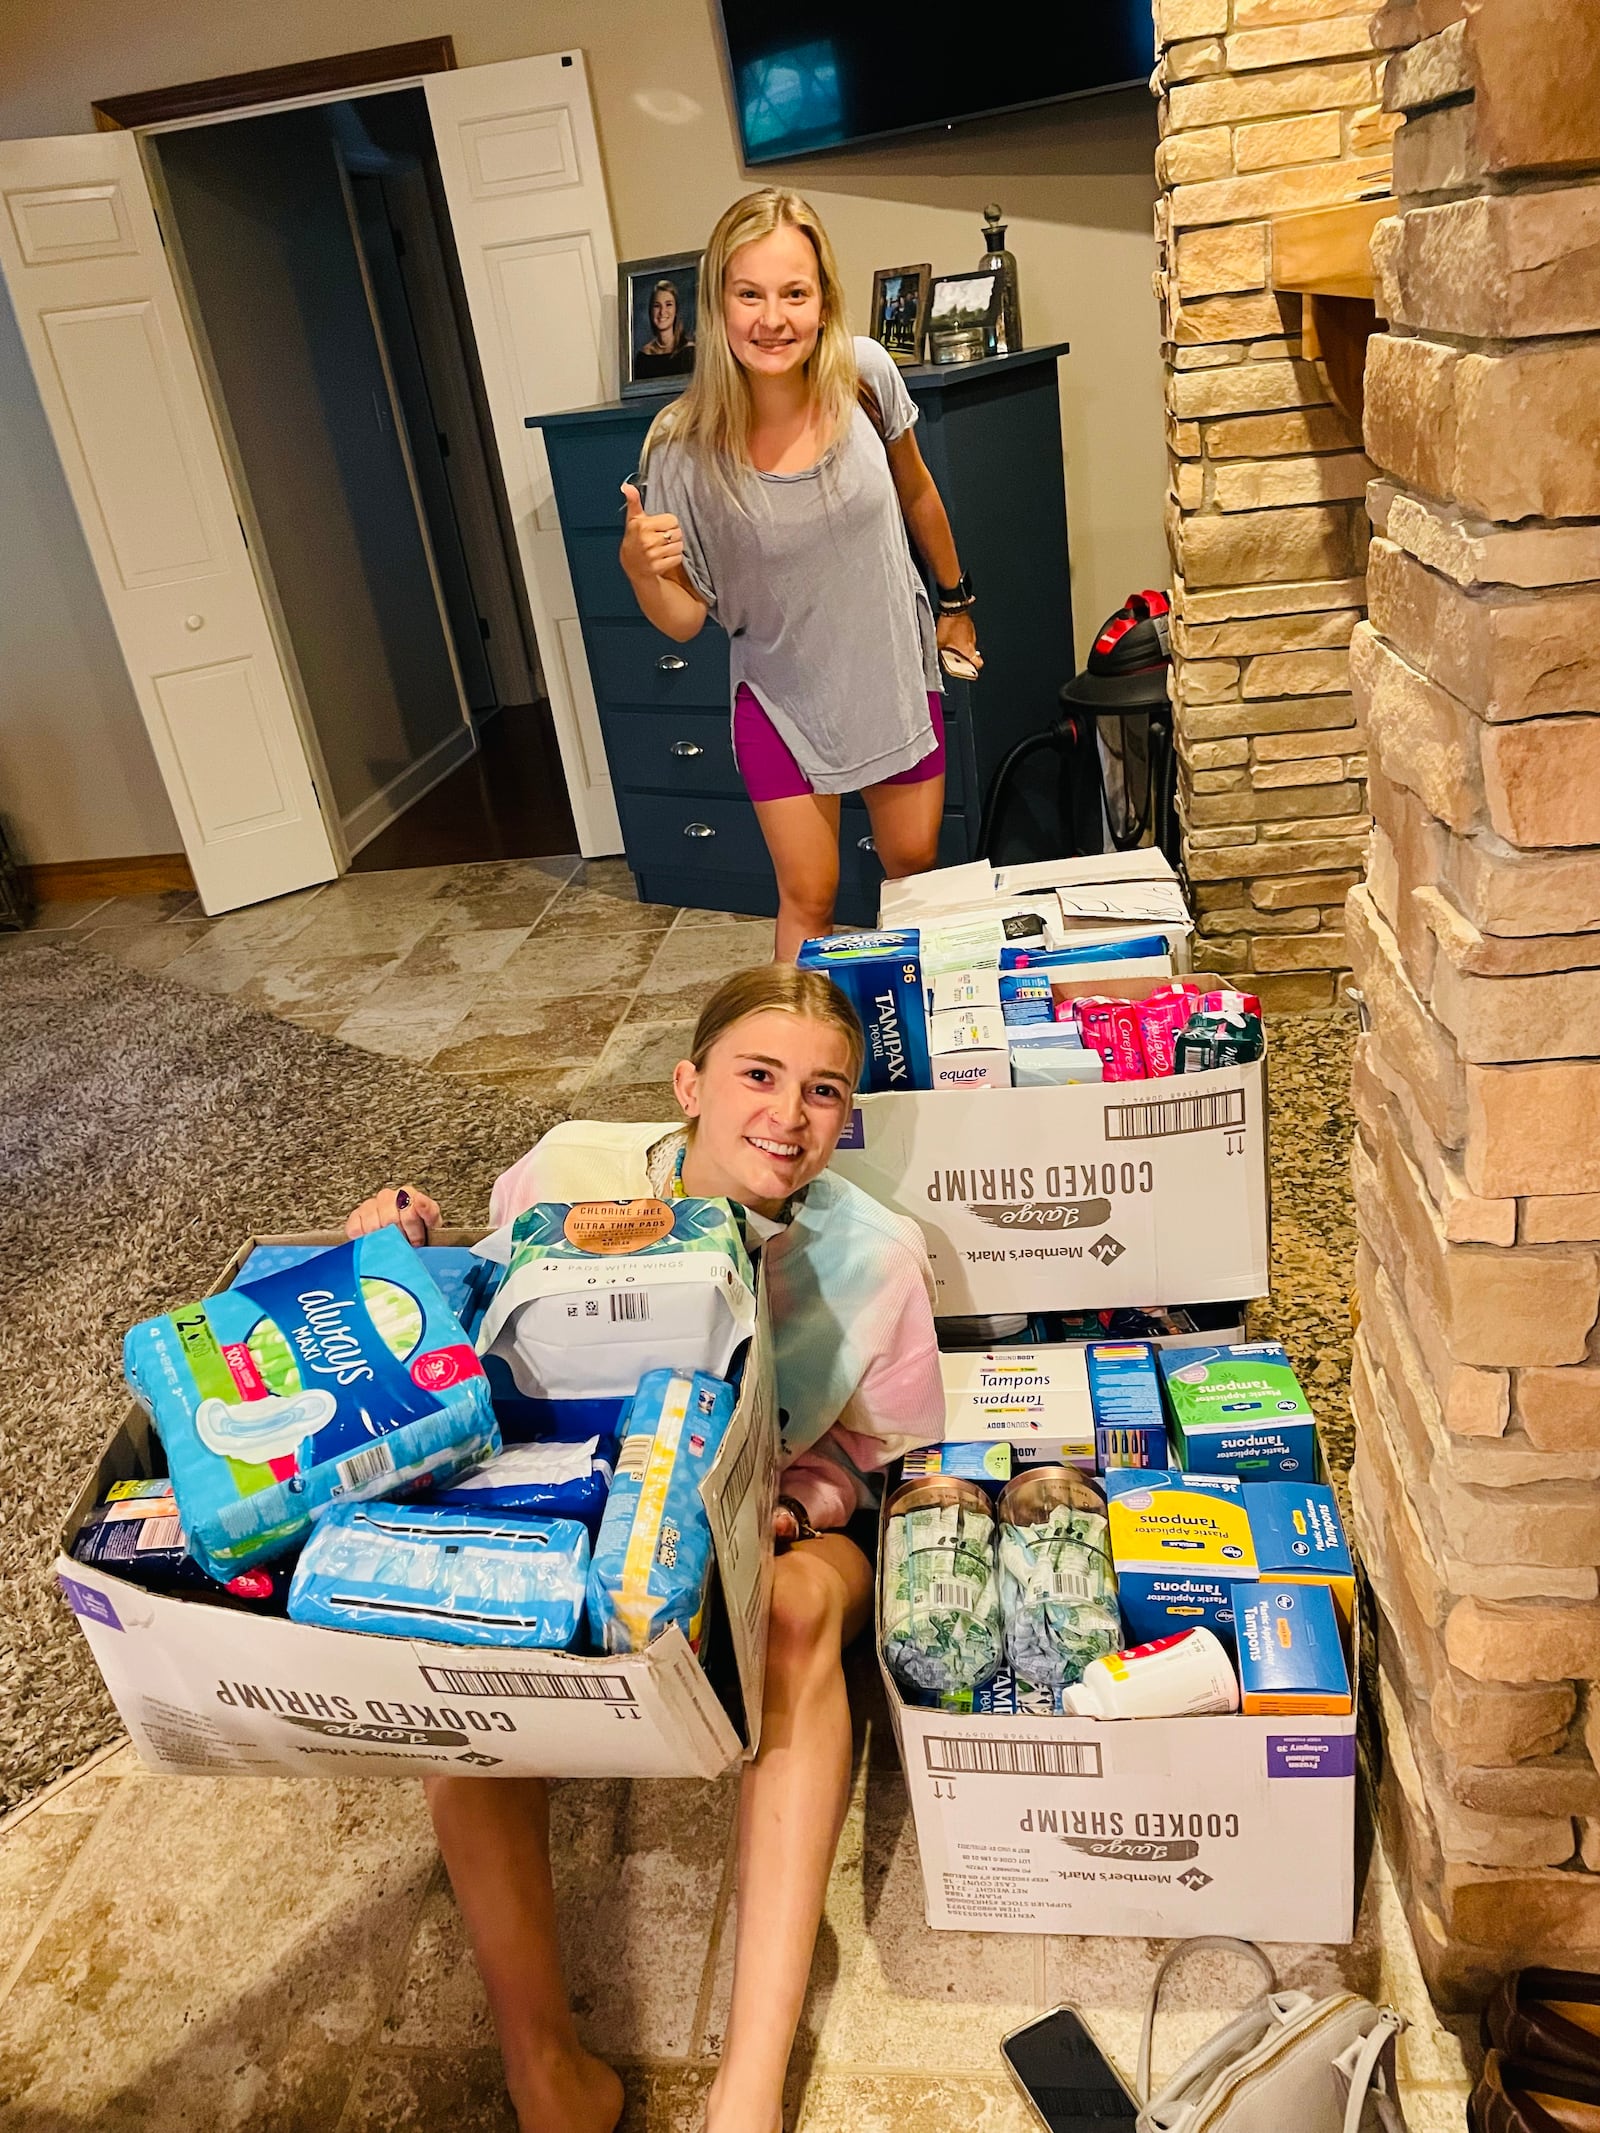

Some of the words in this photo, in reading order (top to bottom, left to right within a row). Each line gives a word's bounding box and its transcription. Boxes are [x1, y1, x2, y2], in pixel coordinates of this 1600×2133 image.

[902, 963, 917, 984] 96
[875, 989, 908, 1082] TAMPAX
[1117, 1017, 1136, 1070] Carefree
[939, 1067, 988, 1083] equate
[927, 1167, 1035, 1201] SHRIMP
[1047, 1161, 1153, 1198] COOKED
[580, 1206, 633, 1216] CHLORINE
[637, 1207, 663, 1216] FREE
[1000, 1203, 1080, 1228] Large
[573, 1222, 607, 1230] ULTRA
[610, 1221, 636, 1230] THIN
[638, 1220, 666, 1229] PADS
[966, 1249, 1006, 1262] Mark
[1009, 1245, 1083, 1261] Member's
[567, 1264, 600, 1272] PADS
[605, 1263, 638, 1272] WITH
[643, 1261, 685, 1270] WINGS
[291, 1326, 323, 1363] MAXI
[297, 1289, 375, 1386] always
[980, 1374, 1051, 1389] Tampons
[1198, 1379, 1273, 1394] Tampons
[973, 1394, 1045, 1406] Tampons
[1195, 1392, 1247, 1403] Applicator
[1249, 1389, 1282, 1398] Plastic
[1221, 1434, 1284, 1449] Tampons
[1216, 1449, 1260, 1459] Applicator
[1260, 1446, 1290, 1456] Plastic
[1221, 1482, 1238, 1494] 36
[1140, 1513, 1220, 1529] Tampons
[1318, 1504, 1339, 1549] Tampons
[1135, 1527, 1190, 1539] Applicator
[1193, 1529, 1229, 1539] Plastic
[1153, 1580, 1222, 1596] Tampons
[1147, 1593, 1196, 1604] Applicator
[1196, 1594, 1228, 1604] Plastic
[1258, 1600, 1271, 1625] Plastic
[1243, 1606, 1262, 1662] Tampons
[216, 1680, 358, 1720] SHRIMP
[365, 1700, 517, 1732] COOKED
[323, 1722, 429, 1745] Large
[1290, 1744, 1329, 1753] Category
[1019, 1808, 1124, 1836] SHRIMP
[1135, 1813, 1239, 1838] COOKED
[1090, 1838, 1168, 1861] Large
[1057, 1869, 1096, 1881] Mark
[1099, 1871, 1172, 1884] Member's
[963, 1879, 993, 1887] COUNT
[975, 1886, 1010, 1894] WEIGHT
